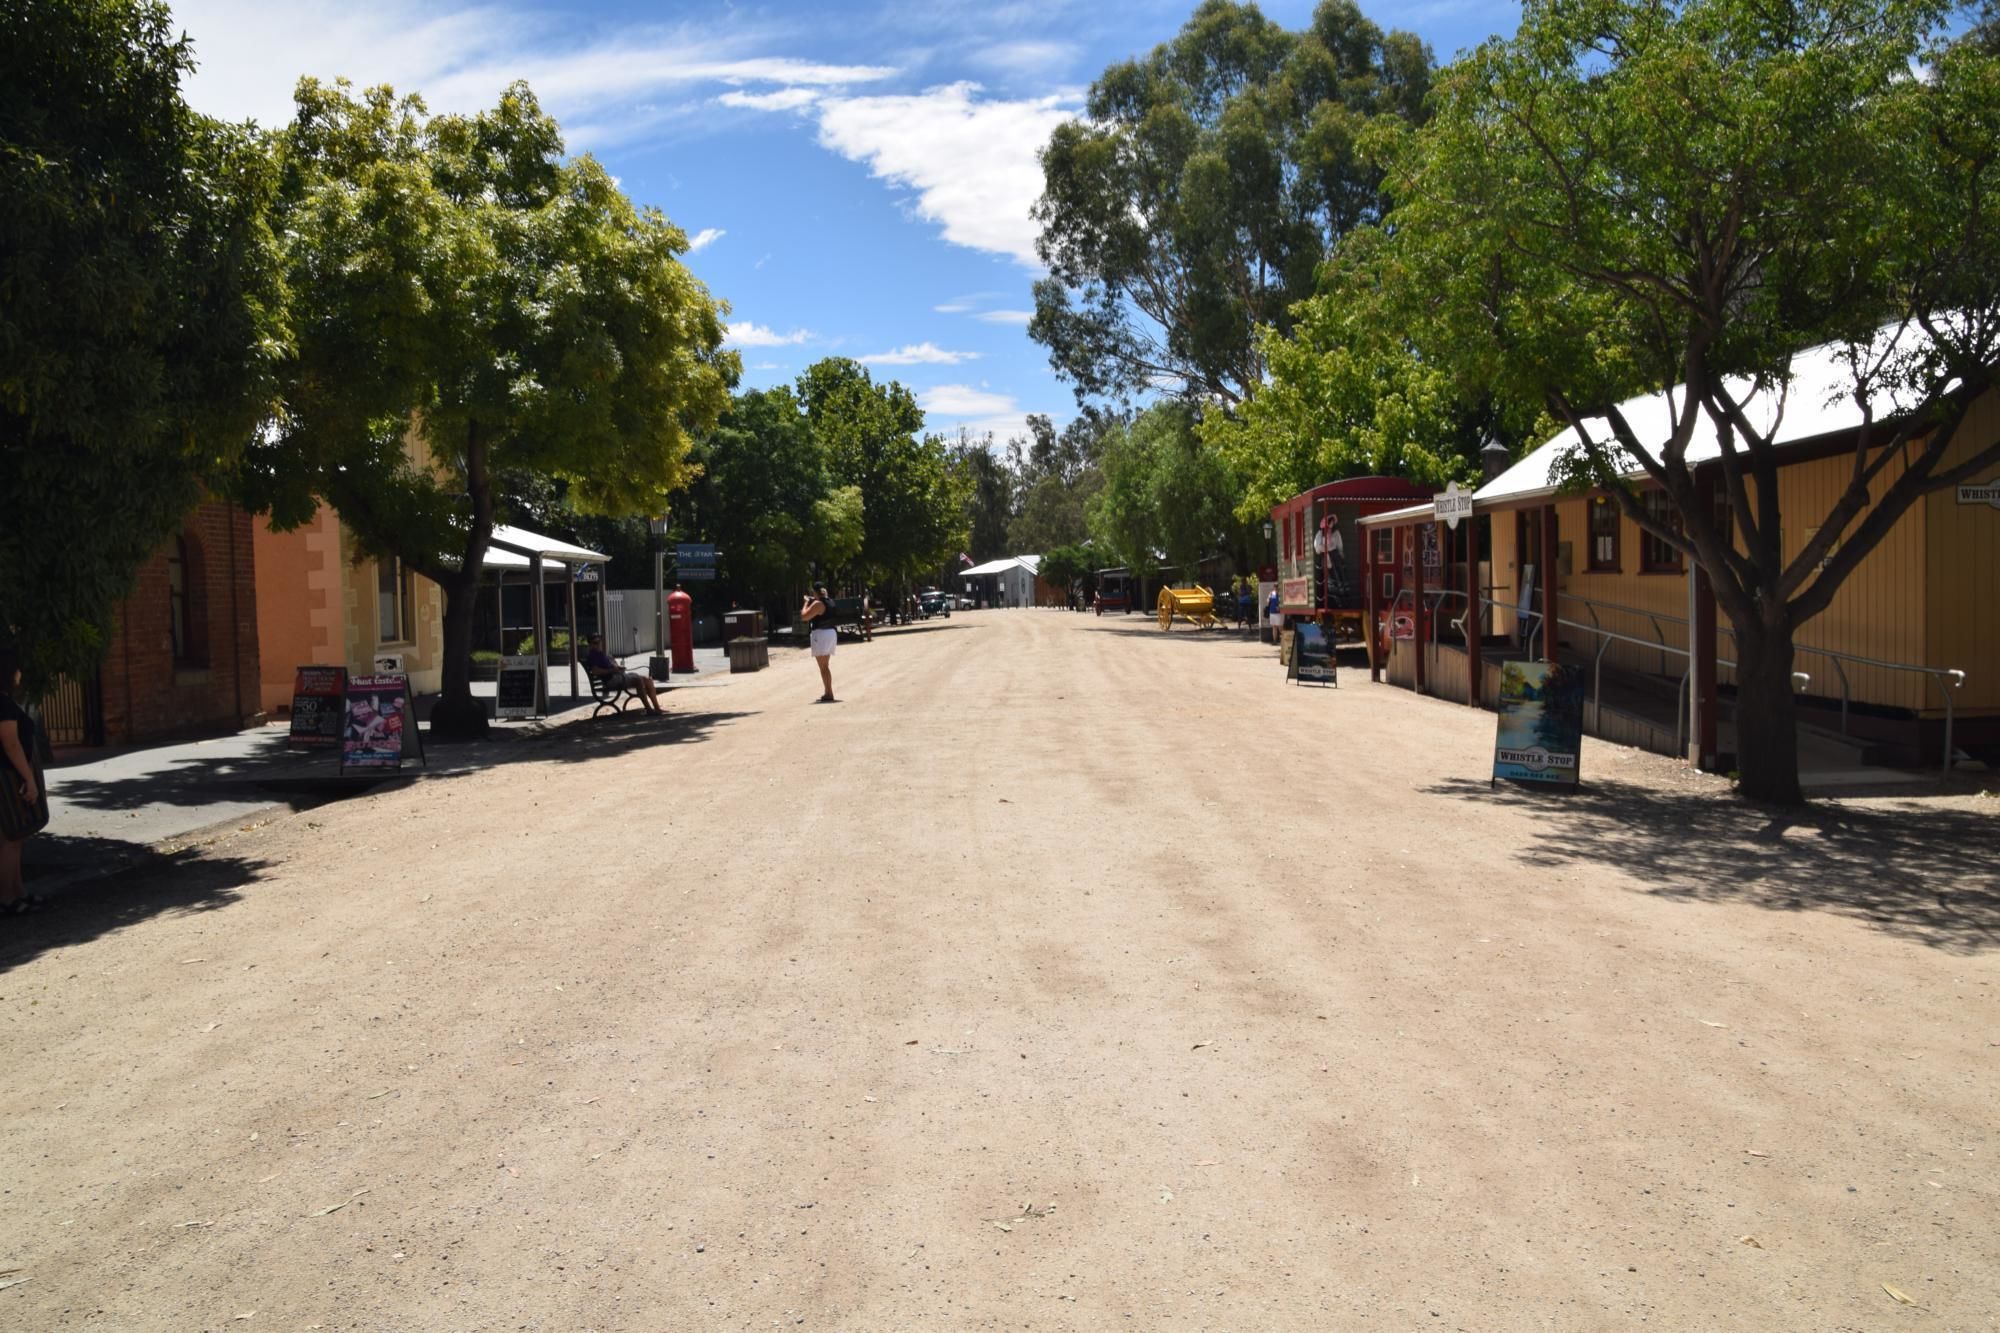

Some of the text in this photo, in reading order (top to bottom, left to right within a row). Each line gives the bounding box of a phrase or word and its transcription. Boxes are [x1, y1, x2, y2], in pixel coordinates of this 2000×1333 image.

[1960, 488, 2000, 499] WHIST
[1436, 496, 1470, 513] WHISTLE STOP
[1501, 751, 1572, 765] WHISTLE STOP
